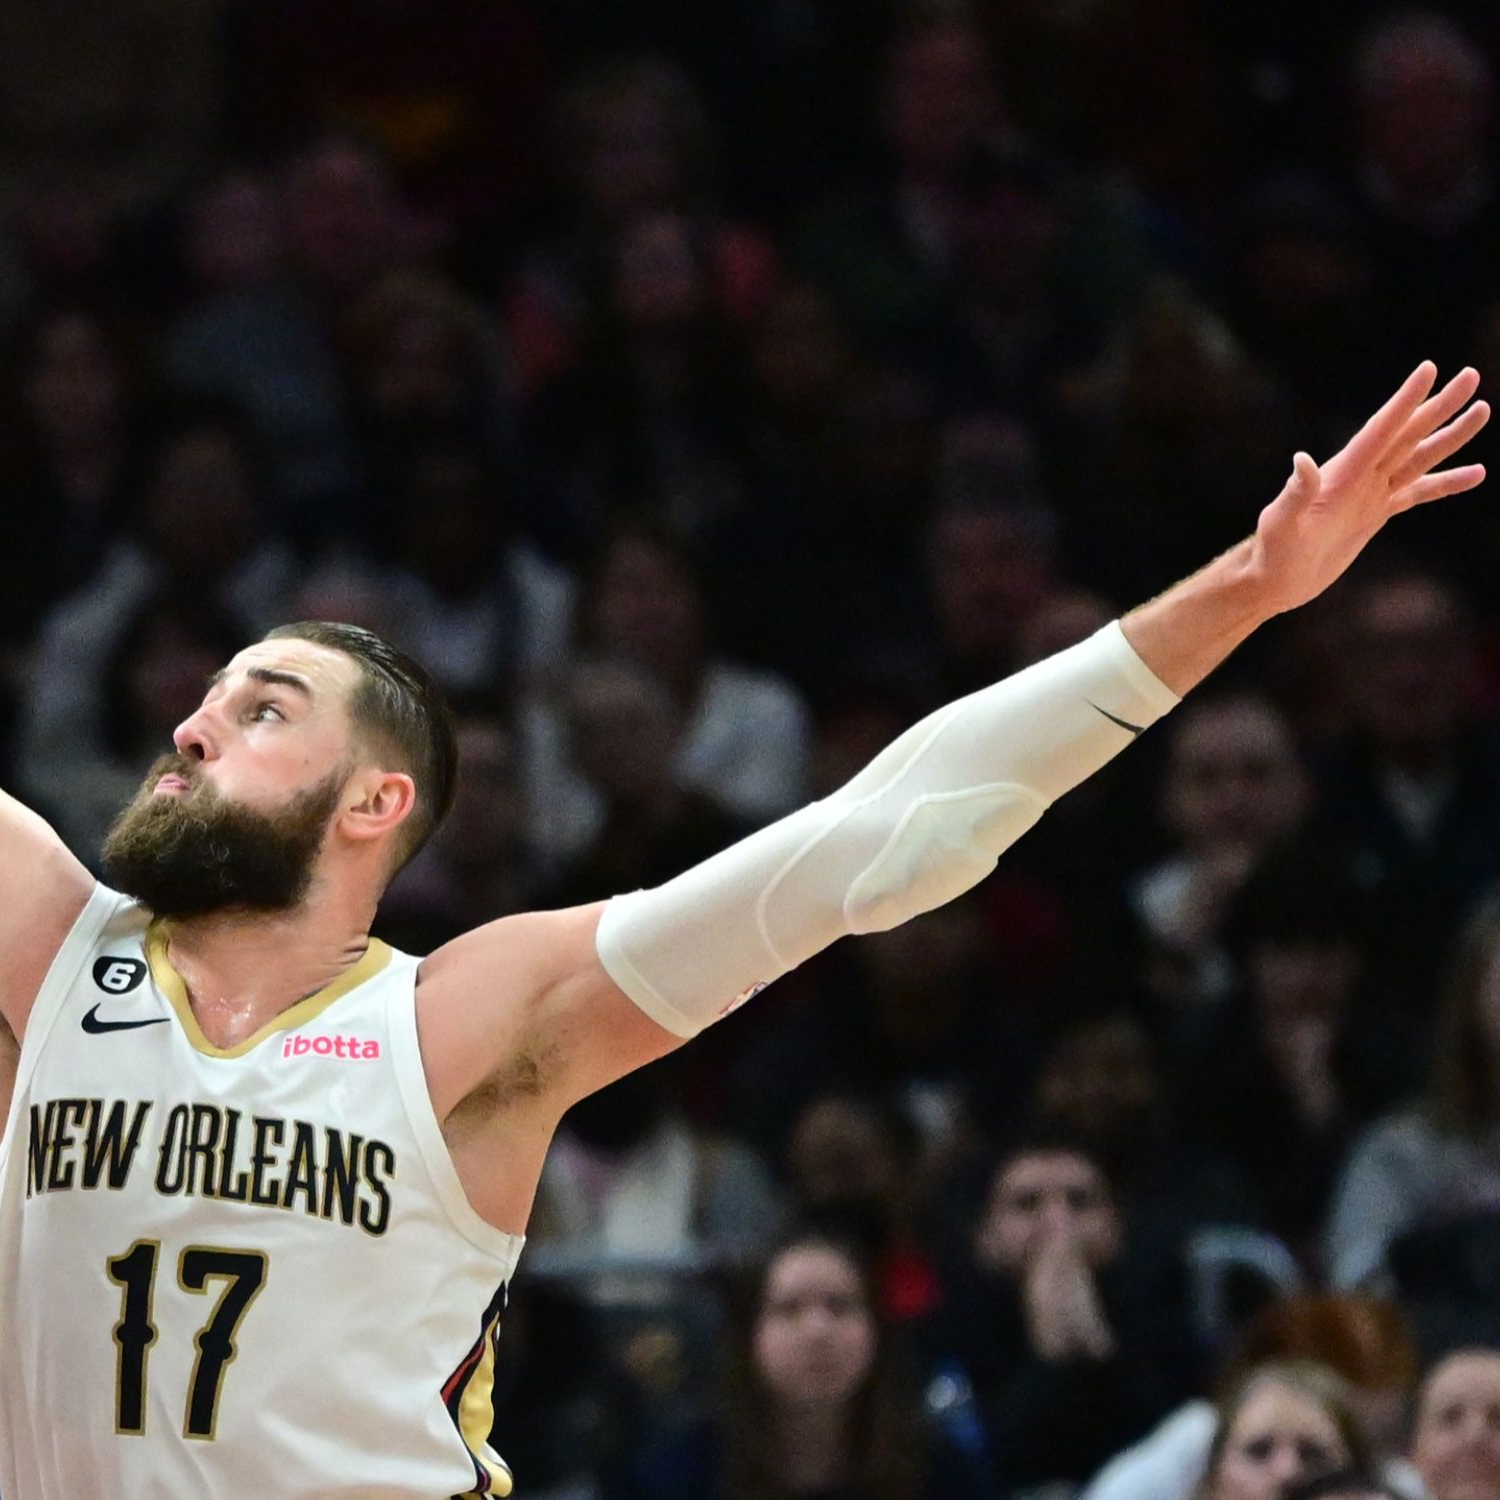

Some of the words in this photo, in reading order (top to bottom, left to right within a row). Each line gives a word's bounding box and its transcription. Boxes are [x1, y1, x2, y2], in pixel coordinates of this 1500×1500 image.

[101, 962, 136, 991] 6
[282, 1034, 381, 1060] ibotta
[26, 1098, 151, 1200] NEW
[155, 1104, 395, 1238] ORLEANS
[106, 1239, 270, 1442] 17
